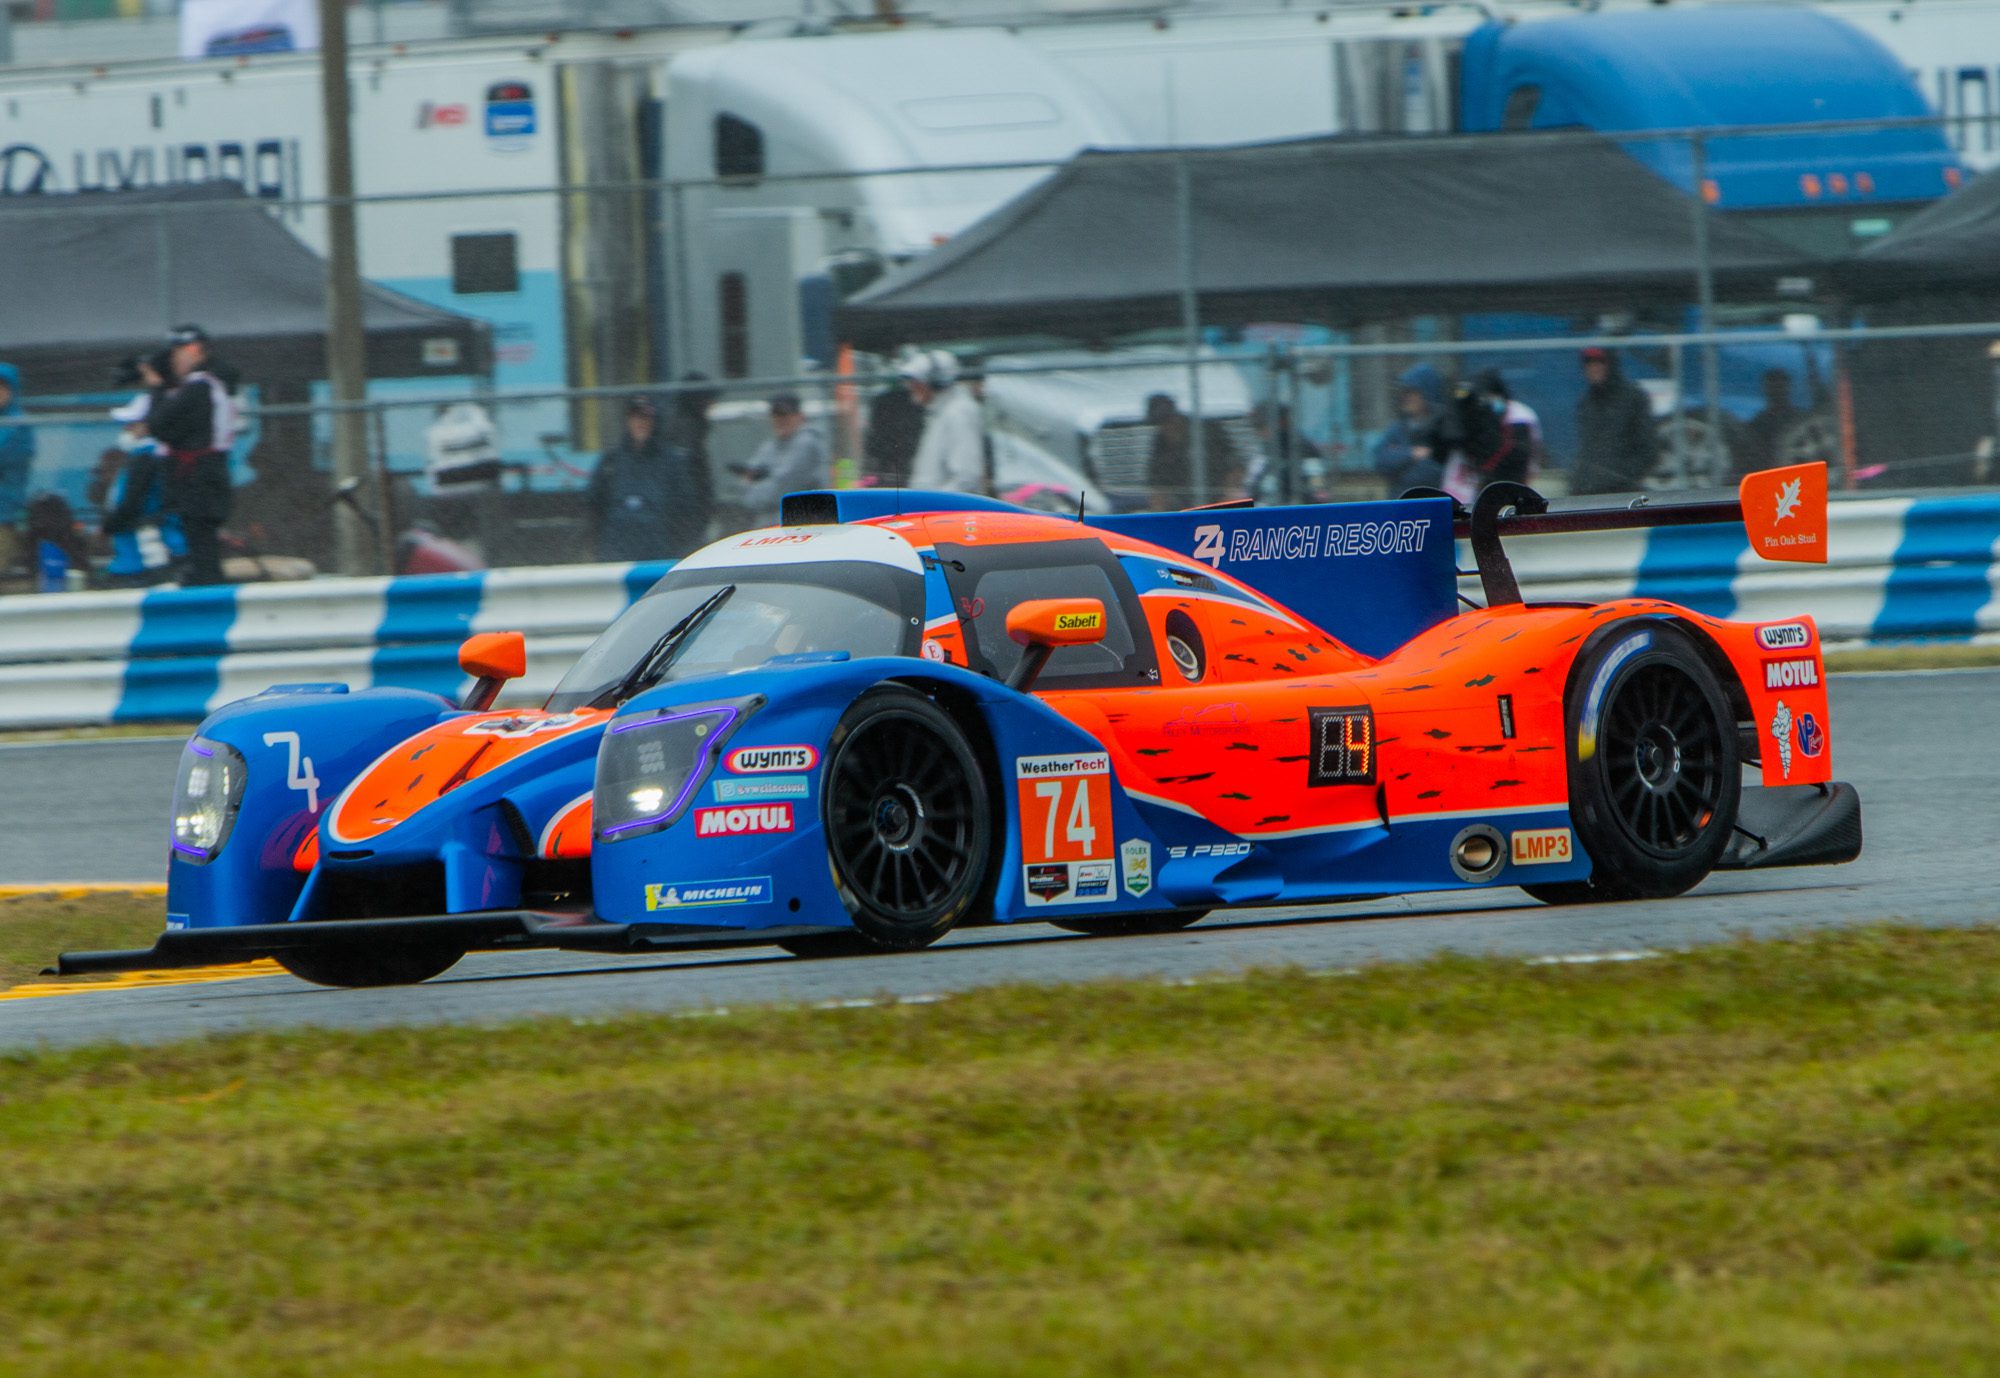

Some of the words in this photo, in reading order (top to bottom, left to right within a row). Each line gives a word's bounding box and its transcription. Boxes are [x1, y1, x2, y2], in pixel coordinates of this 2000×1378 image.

[739, 534, 812, 548] LMP3
[1229, 525, 1320, 562] RANCH
[1324, 520, 1431, 558] RESORT
[1765, 536, 1779, 547] Pin
[1780, 534, 1797, 546] Oak
[1798, 533, 1816, 545] Stud
[1059, 615, 1097, 629] Sabelt
[1767, 660, 1818, 688] MOTUL
[1021, 758, 1107, 774] WeatherTech
[700, 806, 790, 835] MOTUL
[1035, 779, 1096, 858] 74
[1515, 835, 1569, 860] LMP3
[682, 885, 763, 901] MICHELIN
